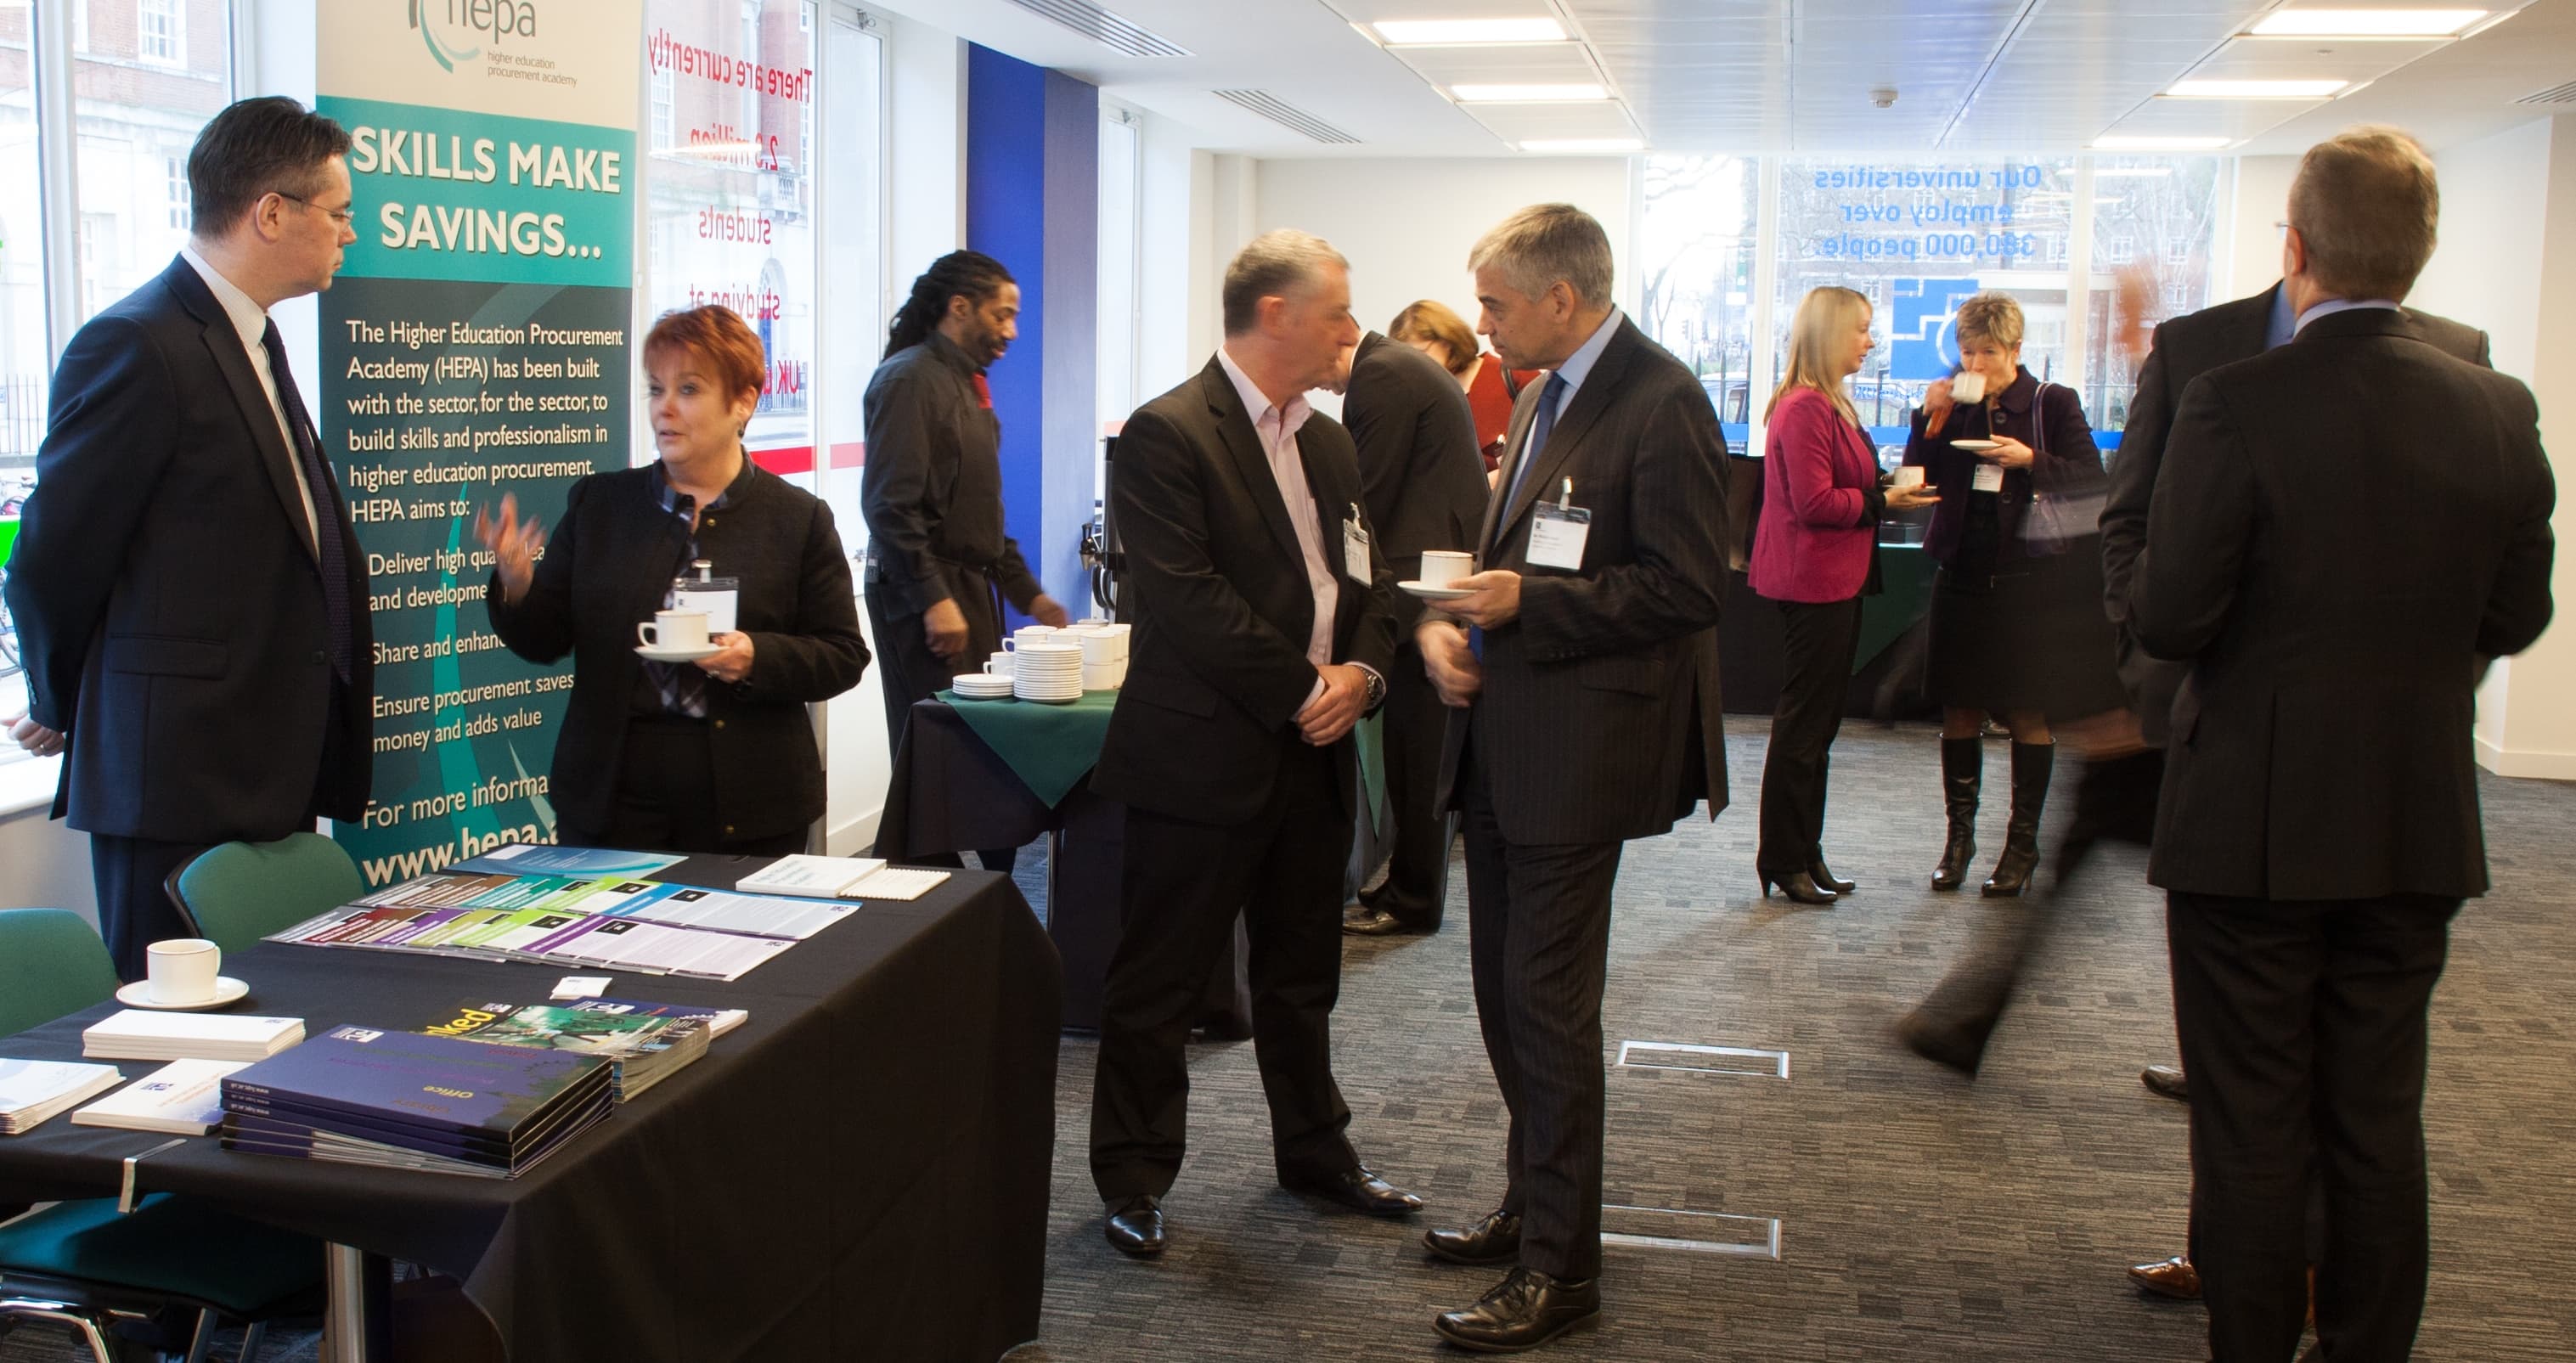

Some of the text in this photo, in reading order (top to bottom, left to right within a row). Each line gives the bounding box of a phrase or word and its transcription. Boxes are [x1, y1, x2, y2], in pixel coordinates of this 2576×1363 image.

[488, 50, 555, 70] higher education
[488, 65, 578, 87] procurement academy
[352, 126, 621, 194] SKILLS MAKE
[380, 202, 602, 258] SAVINGS...
[346, 320, 623, 350] The Higher Education Procurement
[347, 357, 600, 386] Academy (HEPA) has been built
[347, 391, 608, 415] with the sector, for the sector, to
[348, 425, 608, 453] build skills and professionalism in
[349, 459, 595, 493] higher education procurement.
[351, 498, 471, 523] HEPA aims to:
[368, 552, 431, 577] Deliver
[436, 547, 465, 574] high
[471, 549, 497, 572] qua
[369, 583, 488, 611] and developme
[373, 643, 419, 665] Share
[424, 634, 451, 658] and
[373, 674, 575, 718] Ensure procurement saves
[374, 707, 542, 752] money and adds value
[363, 774, 550, 830] For more informa
[423, 1084, 475, 1099] Office
